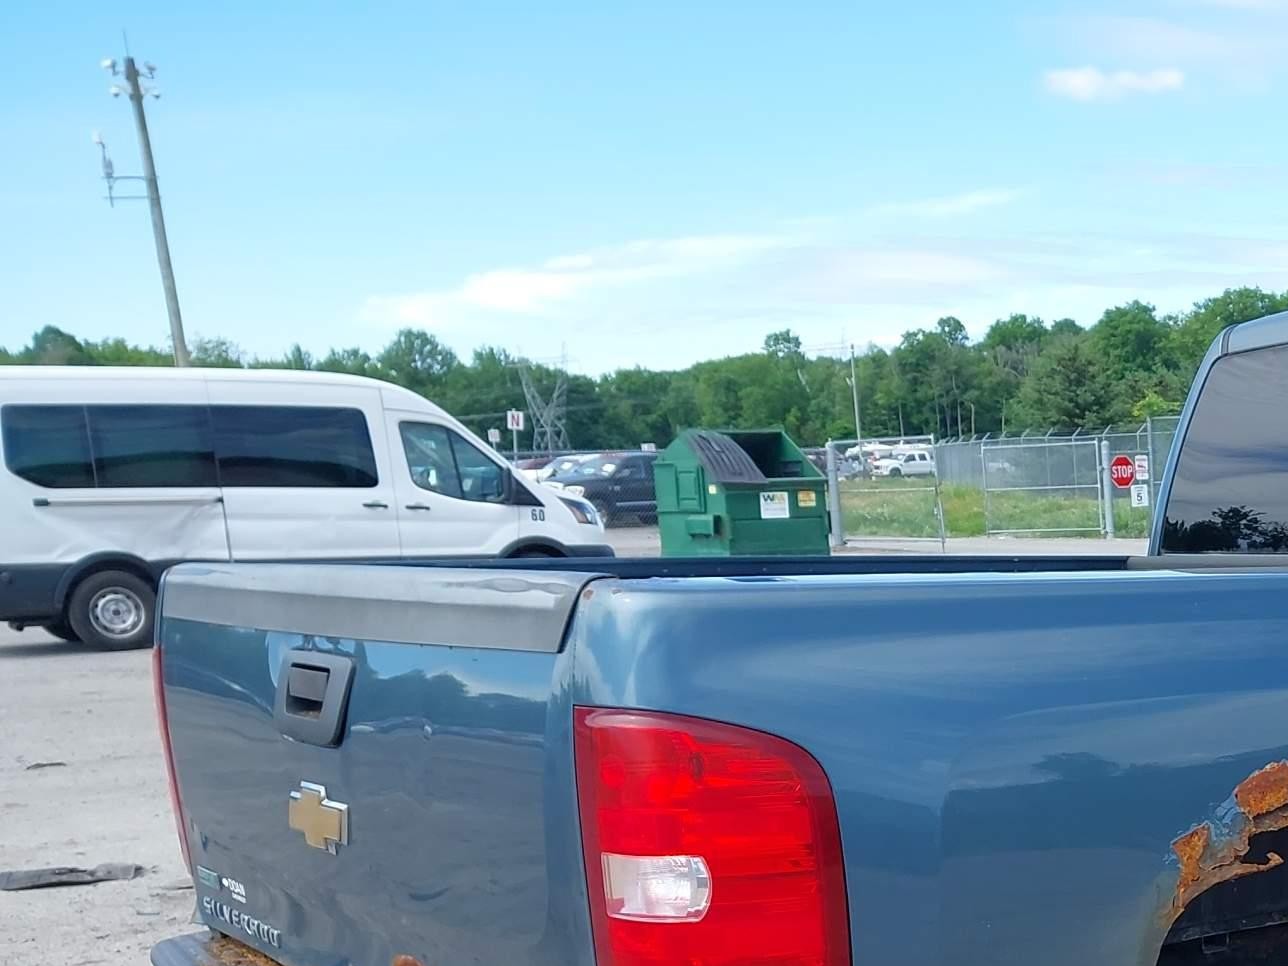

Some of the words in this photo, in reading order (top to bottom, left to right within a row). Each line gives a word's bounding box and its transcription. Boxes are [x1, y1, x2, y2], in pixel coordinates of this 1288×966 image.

[511, 413, 520, 427] N
[1111, 465, 1133, 479] STOP
[531, 508, 545, 521] 60
[203, 895, 281, 948] SILVERADO
